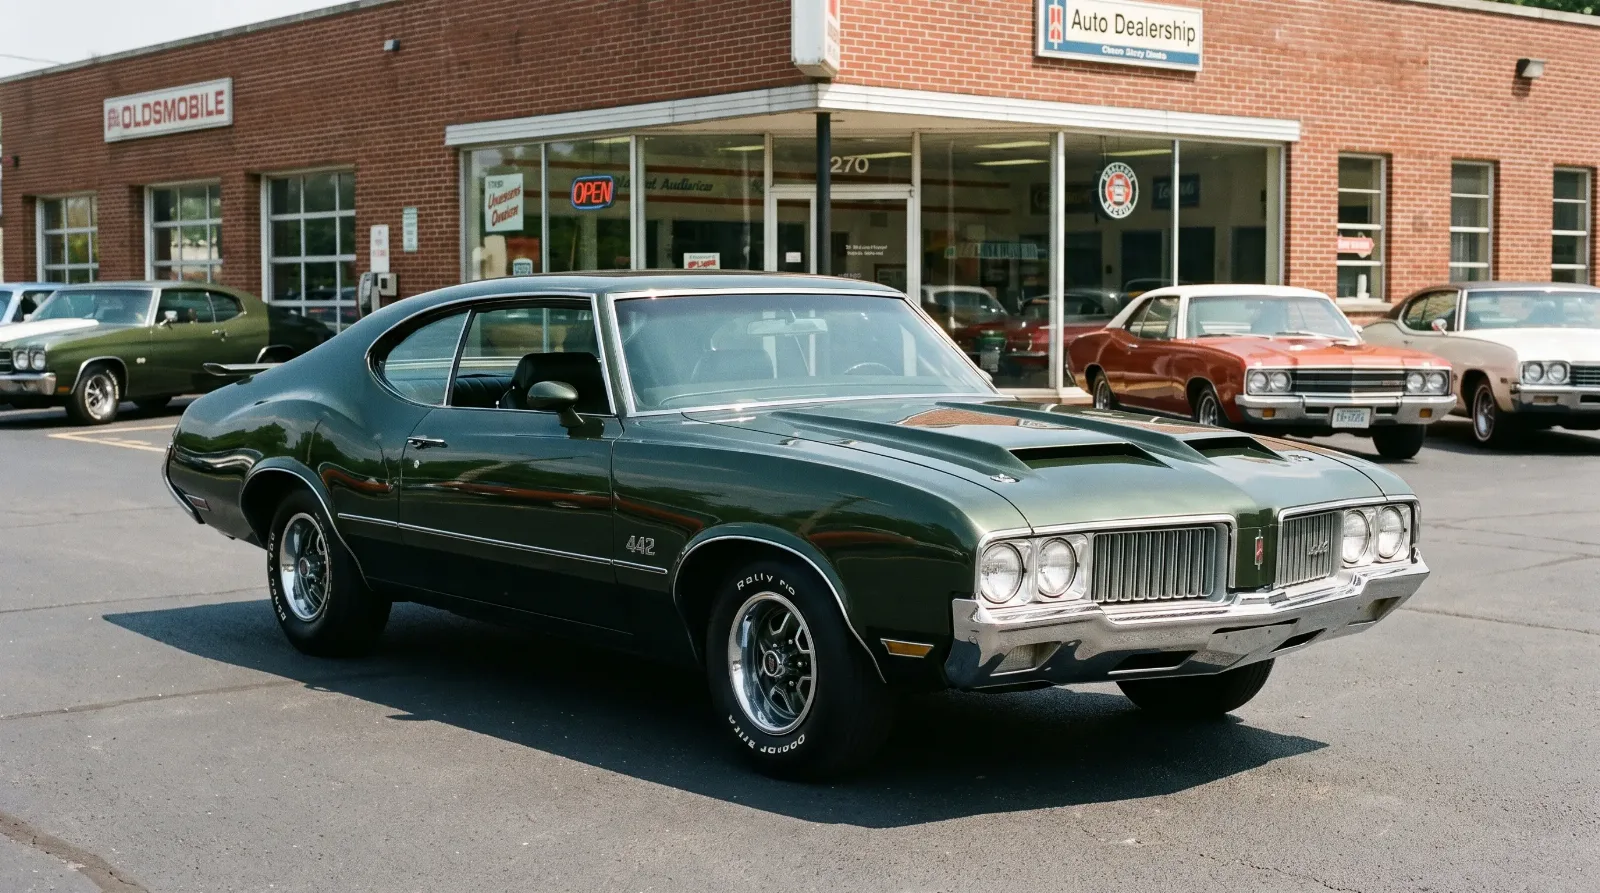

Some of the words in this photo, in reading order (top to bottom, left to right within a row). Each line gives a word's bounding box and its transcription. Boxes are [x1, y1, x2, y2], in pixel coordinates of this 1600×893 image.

[1071, 9, 1108, 33] Auto
[1115, 13, 1196, 46] Dealership
[121, 89, 225, 129] OLDSMOBILE
[830, 156, 869, 173] 270
[573, 181, 612, 204] OPEN
[626, 535, 656, 556] 442
